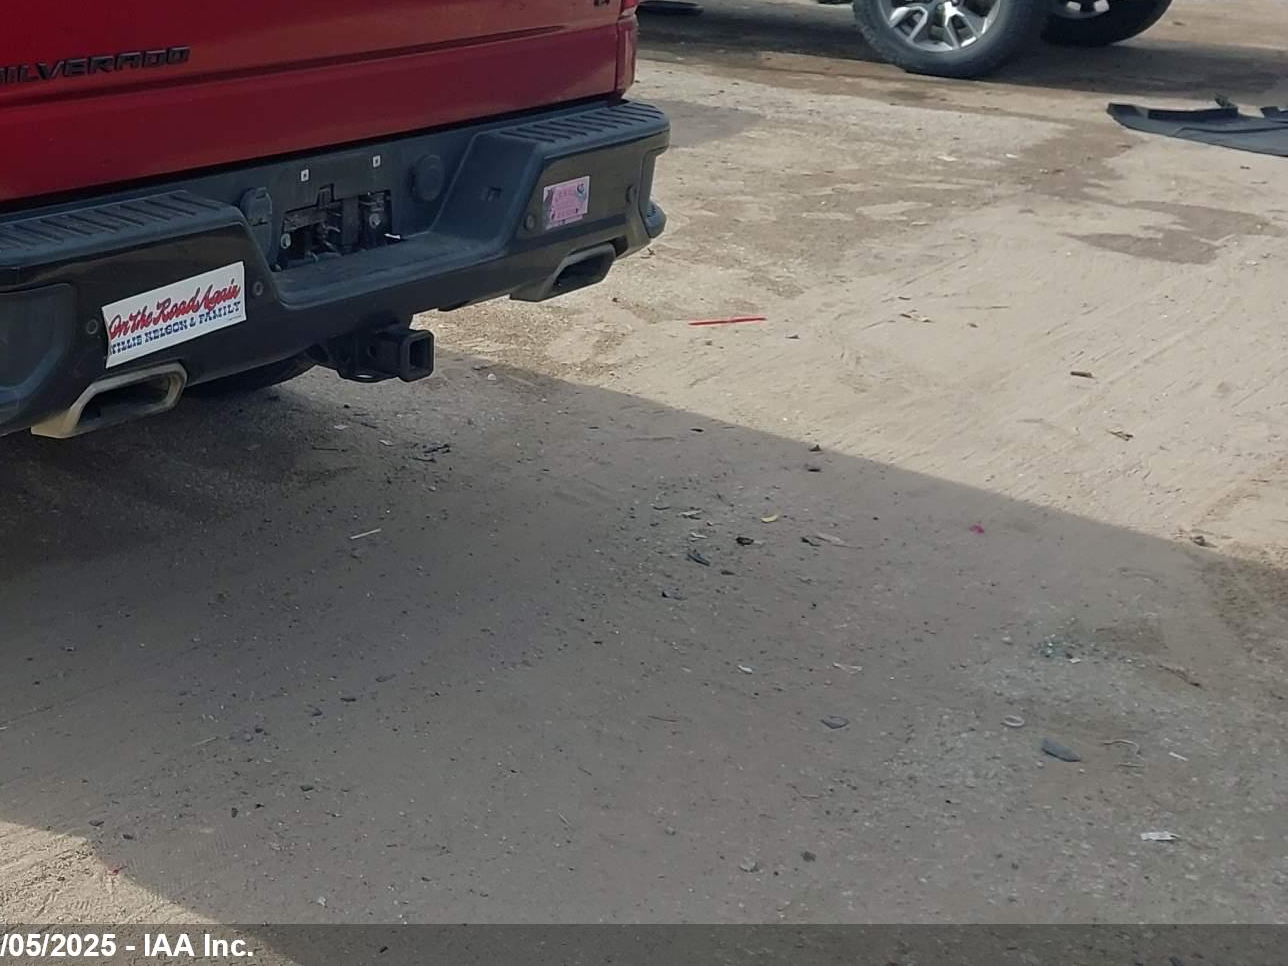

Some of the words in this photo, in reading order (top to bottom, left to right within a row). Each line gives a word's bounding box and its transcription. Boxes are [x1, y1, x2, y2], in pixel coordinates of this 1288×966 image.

[109, 315, 130, 340] On
[153, 287, 200, 326] Road
[198, 278, 241, 312] Again
[144, 319, 188, 343] NELSON
[199, 301, 241, 324] FAMILY
